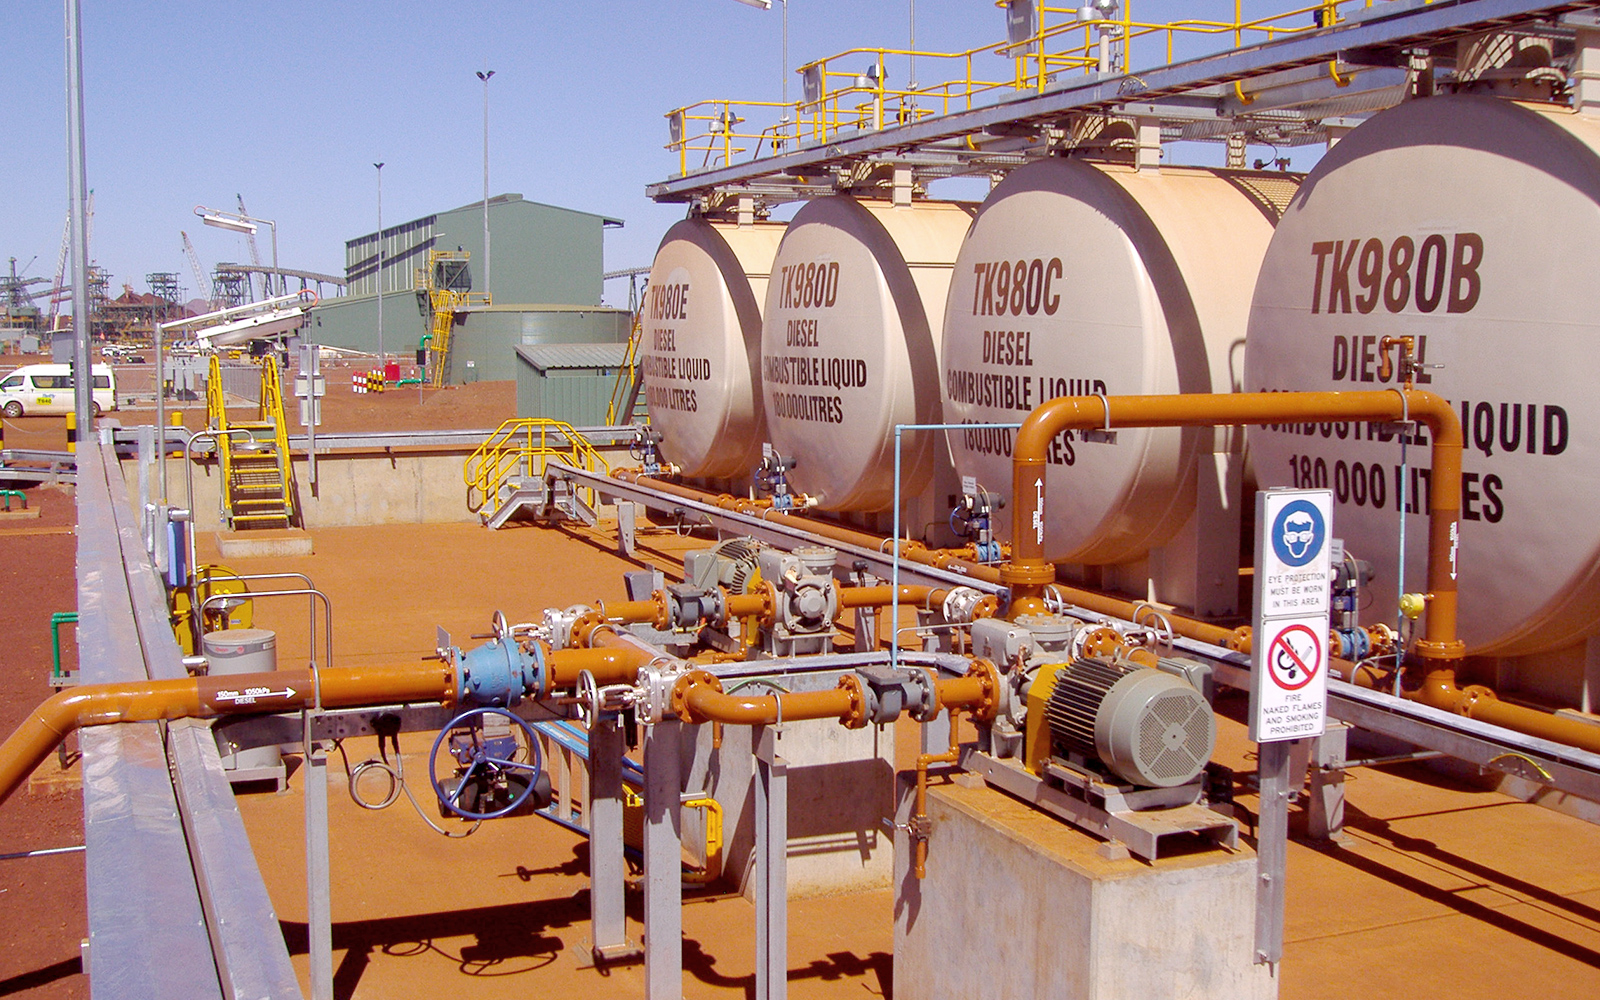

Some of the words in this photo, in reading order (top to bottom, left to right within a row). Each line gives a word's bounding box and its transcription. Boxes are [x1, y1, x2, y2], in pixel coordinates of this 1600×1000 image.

[779, 261, 839, 309] TK980D
[1311, 232, 1484, 314] TK980B
[972, 257, 1063, 316] TK980C
[650, 284, 689, 320] TK980E
[653, 328, 676, 351] DIESEL
[787, 319, 819, 347] DIESEL
[982, 330, 1033, 366] DIESEL
[678, 358, 711, 382] LIQUID
[821, 358, 867, 390] LIQUID
[669, 388, 697, 413] LITRES
[947, 368, 1033, 411] COMBUSTIBLE
[1446, 400, 1569, 457] IQUID
[1395, 465, 1504, 524] LITES
[1268, 575, 1282, 584] EYE
[1285, 572, 1326, 582] PROTECTION
[1271, 586, 1289, 595] MUST
[1292, 586, 1301, 594] BE
[1304, 585, 1323, 593] WORN
[1283, 599, 1298, 607] THIS
[1302, 597, 1320, 605] AREA
[244, 687, 270, 696] 1050kPa
[1285, 694, 1302, 702] FIRE
[1263, 705, 1290, 714] NAKED
[1293, 702, 1322, 711] FLAMES
[1266, 716, 1282, 725] AND
[1286, 712, 1319, 723] SMOKING
[1270, 723, 1314, 734] PROHIBITED
